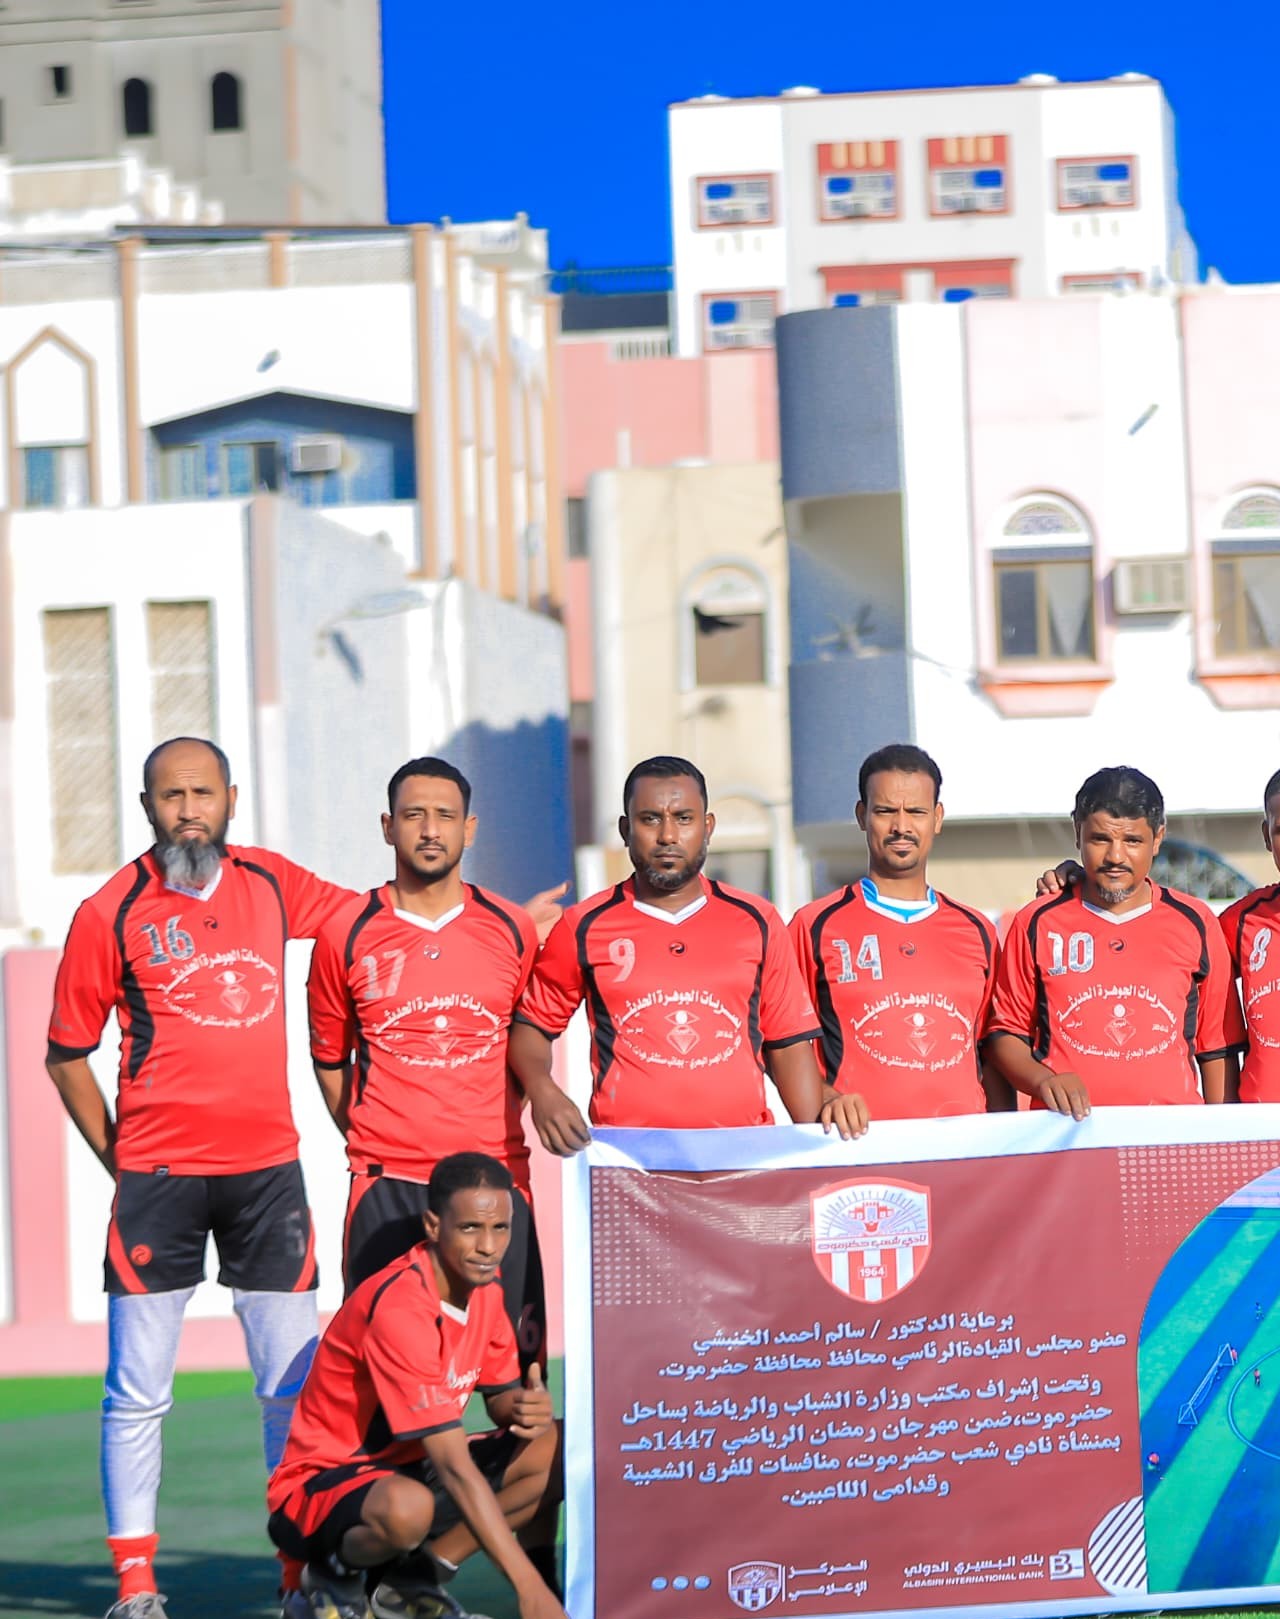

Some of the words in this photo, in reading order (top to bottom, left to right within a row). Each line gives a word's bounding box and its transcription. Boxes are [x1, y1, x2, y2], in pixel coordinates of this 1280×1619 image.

[141, 915, 196, 967] 16
[1249, 927, 1272, 972] 8
[608, 938, 635, 982] 9
[832, 934, 883, 984] 14
[1047, 931, 1094, 976] 10
[361, 949, 407, 1000] 17
[658, 989, 699, 1006] الجوهرة
[895, 992, 934, 1009] الجوهرة
[1098, 984, 1136, 1000] الجوهرة
[700, 990, 742, 1032] بصريات
[1138, 985, 1177, 1028] بصريات
[860, 1267, 884, 1277] 1964
[774, 1322, 820, 1344] أحمد
[825, 1322, 865, 1345] سالم
[870, 1319, 881, 1340] /
[887, 1313, 954, 1341] الدكتور
[959, 1311, 1014, 1332] برعاية
[692, 1328, 769, 1356] الخنبشي
[1025, 1334, 1083, 1357] مجلس
[1088, 1331, 1126, 1353] عضو
[753, 1354, 821, 1373] محافظة
[827, 1348, 886, 1367] محافظ
[916, 1383, 970, 1408] مكتب
[976, 1377, 1039, 1403] إشراف
[1044, 1374, 1102, 1396] وتحت
[693, 1396, 778, 1421] والرياضة
[784, 1390, 850, 1417] الشباب
[856, 1387, 911, 1412] وزارة
[623, 1401, 688, 1425] بساحل
[722, 1424, 804, 1456] الرياضي
[809, 1420, 877, 1445] رمضان
[882, 1416, 958, 1441] مهرجان
[951, 1441, 999, 1465] شعب
[1005, 1436, 1053, 1465] نادي
[1058, 1431, 1121, 1452] بمنشأة
[623, 1461, 694, 1485] الشعبية
[699, 1457, 753, 1483] للفرق
[759, 1452, 841, 1475] منافسات
[788, 1559, 868, 1579] المركز
[904, 1561, 949, 1577] الدولي
[954, 1556, 1015, 1575] البسيري
[1021, 1553, 1044, 1567] بنك
[945, 1573, 1017, 1586] INTERNATIONAL
[1019, 1570, 1044, 1580] BANK
[788, 1580, 868, 1602] الإعلامي
